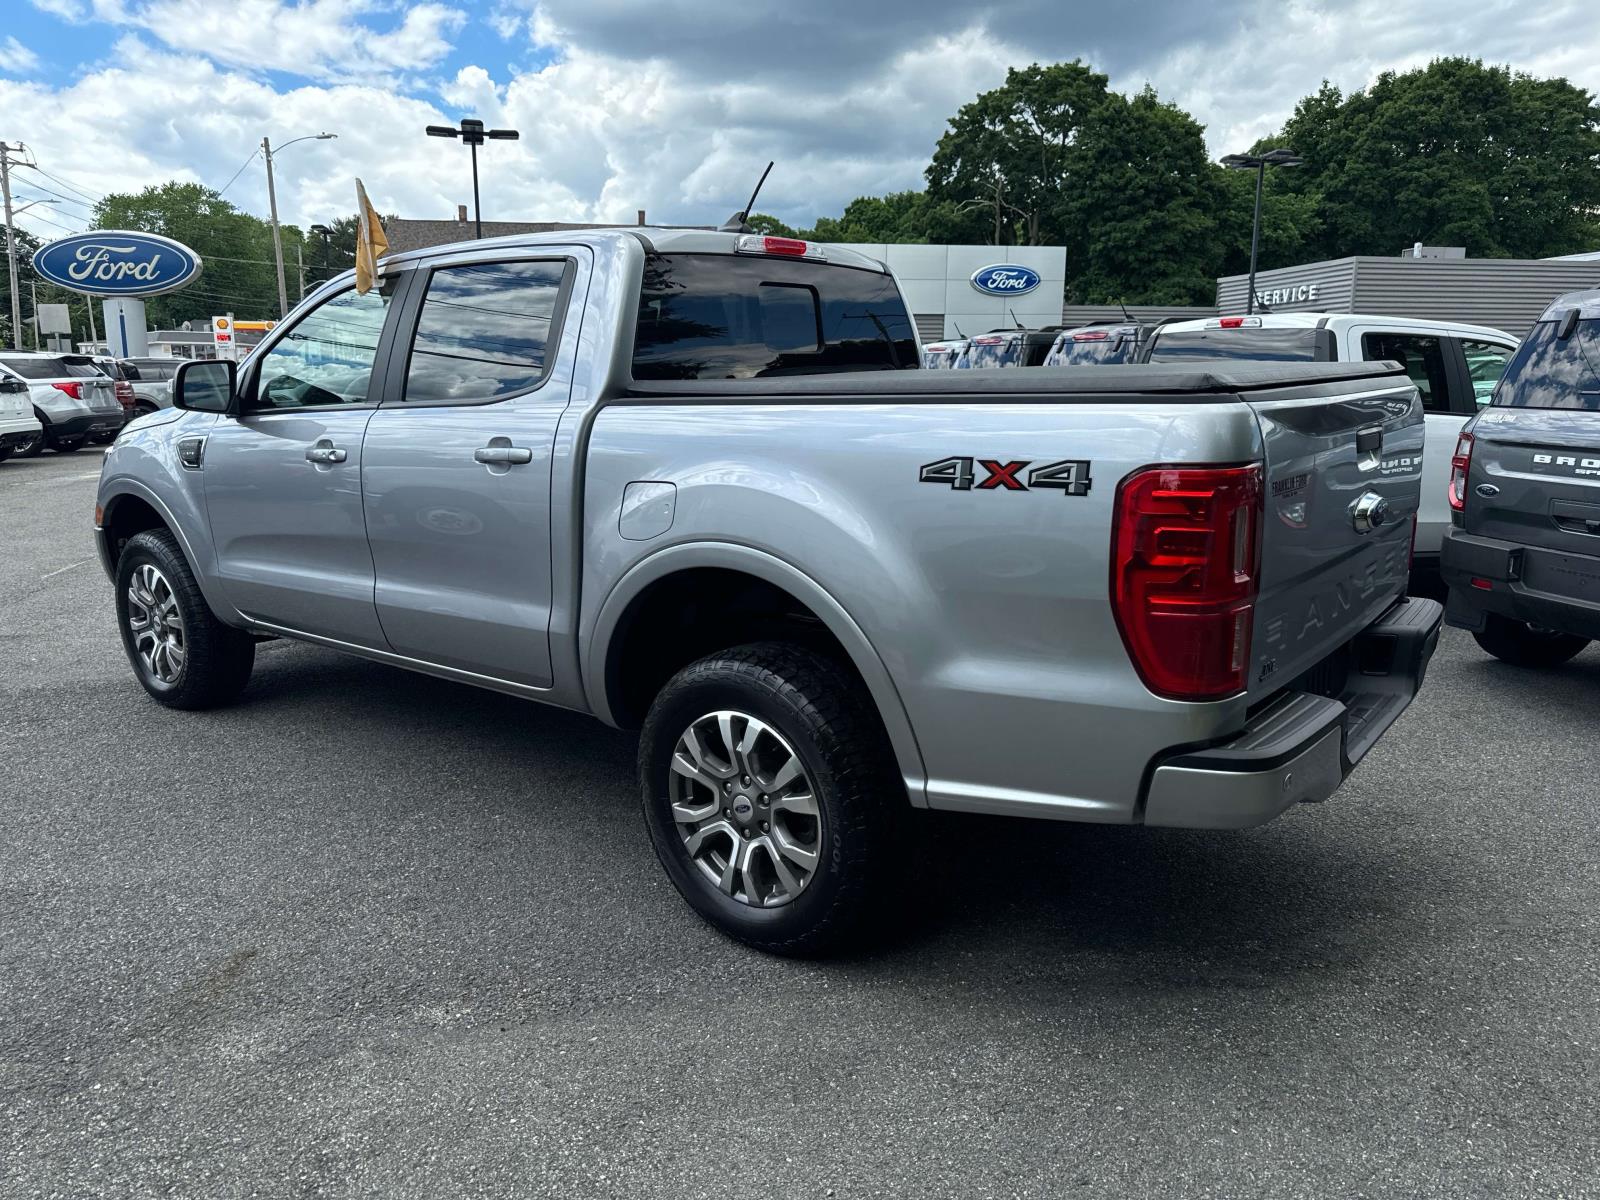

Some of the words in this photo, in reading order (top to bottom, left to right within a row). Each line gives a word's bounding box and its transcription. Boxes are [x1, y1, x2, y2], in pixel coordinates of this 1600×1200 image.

[68, 244, 162, 281] Ford
[987, 270, 1028, 289] Ford
[1254, 284, 1317, 306] SERVICE
